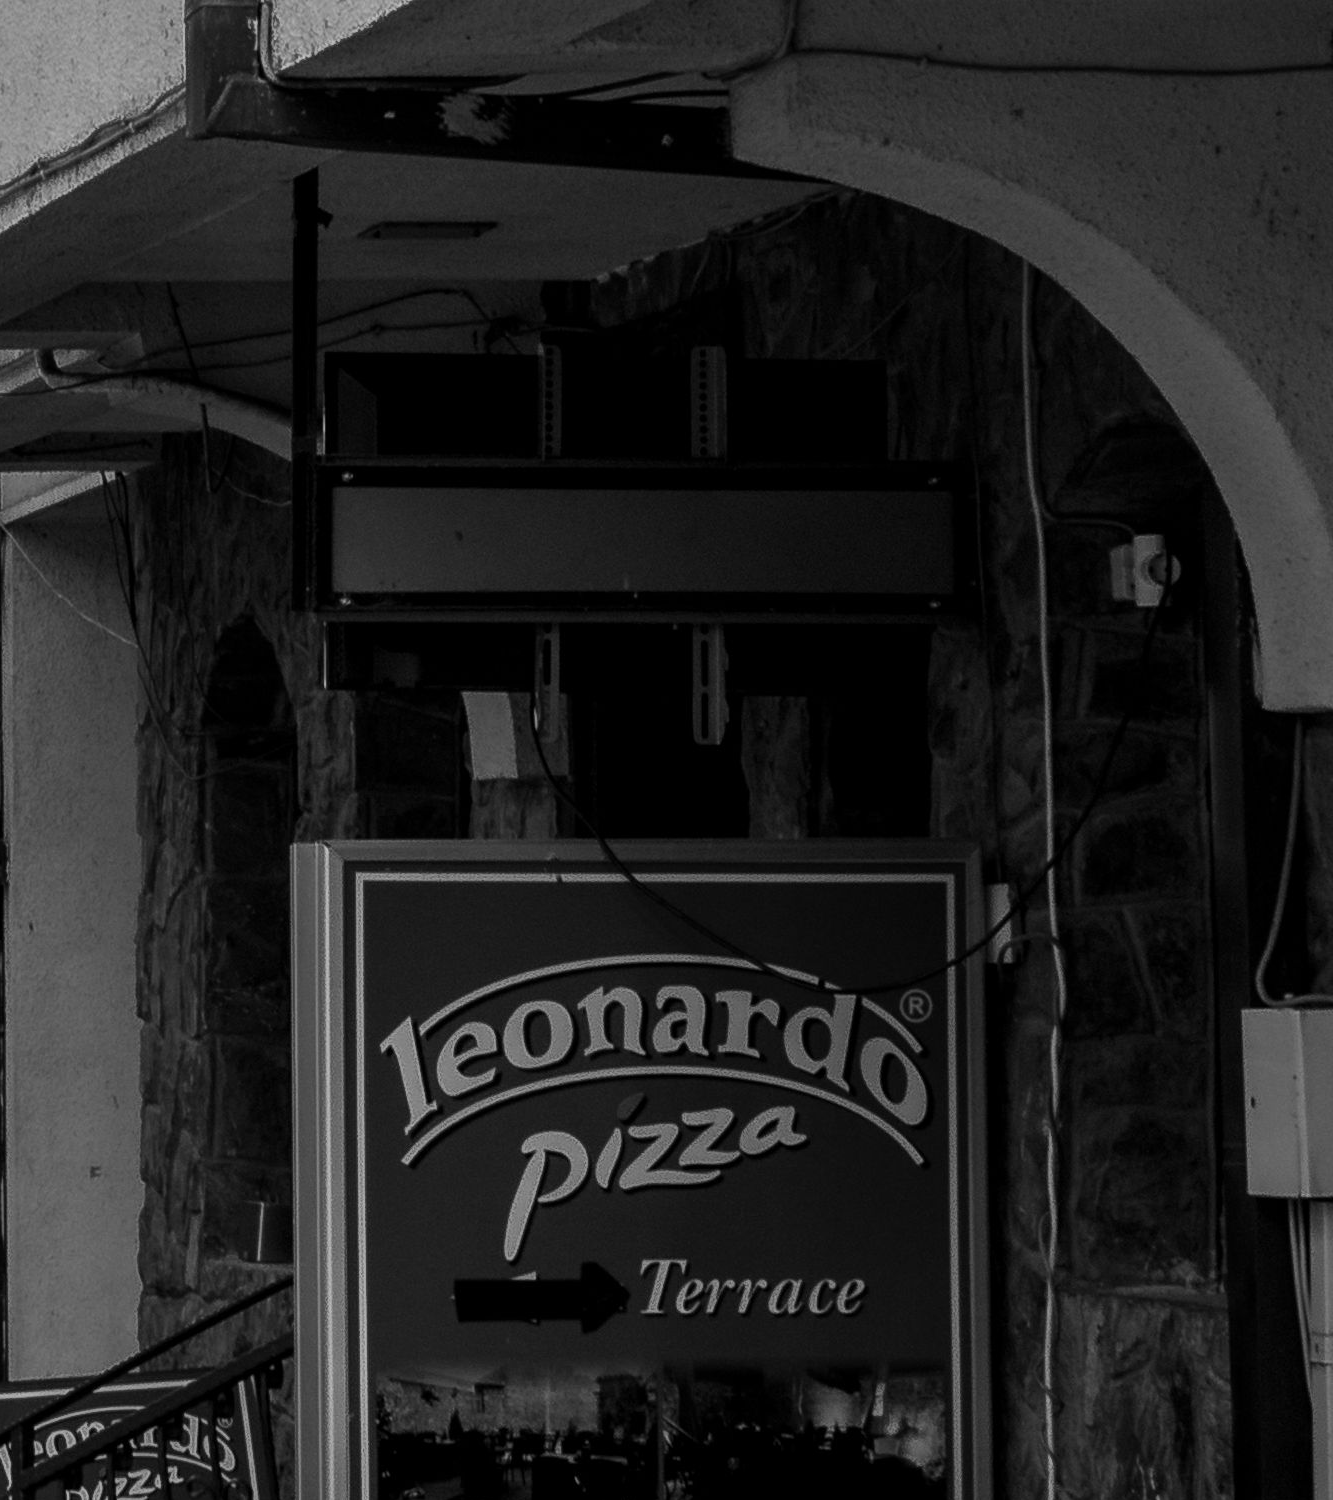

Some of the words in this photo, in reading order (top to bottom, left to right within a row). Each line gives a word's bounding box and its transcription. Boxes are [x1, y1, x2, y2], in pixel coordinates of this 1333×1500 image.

[380, 983, 928, 1136] leonardo
[504, 1092, 807, 1263] pizza
[639, 1258, 866, 1317] Terrace
